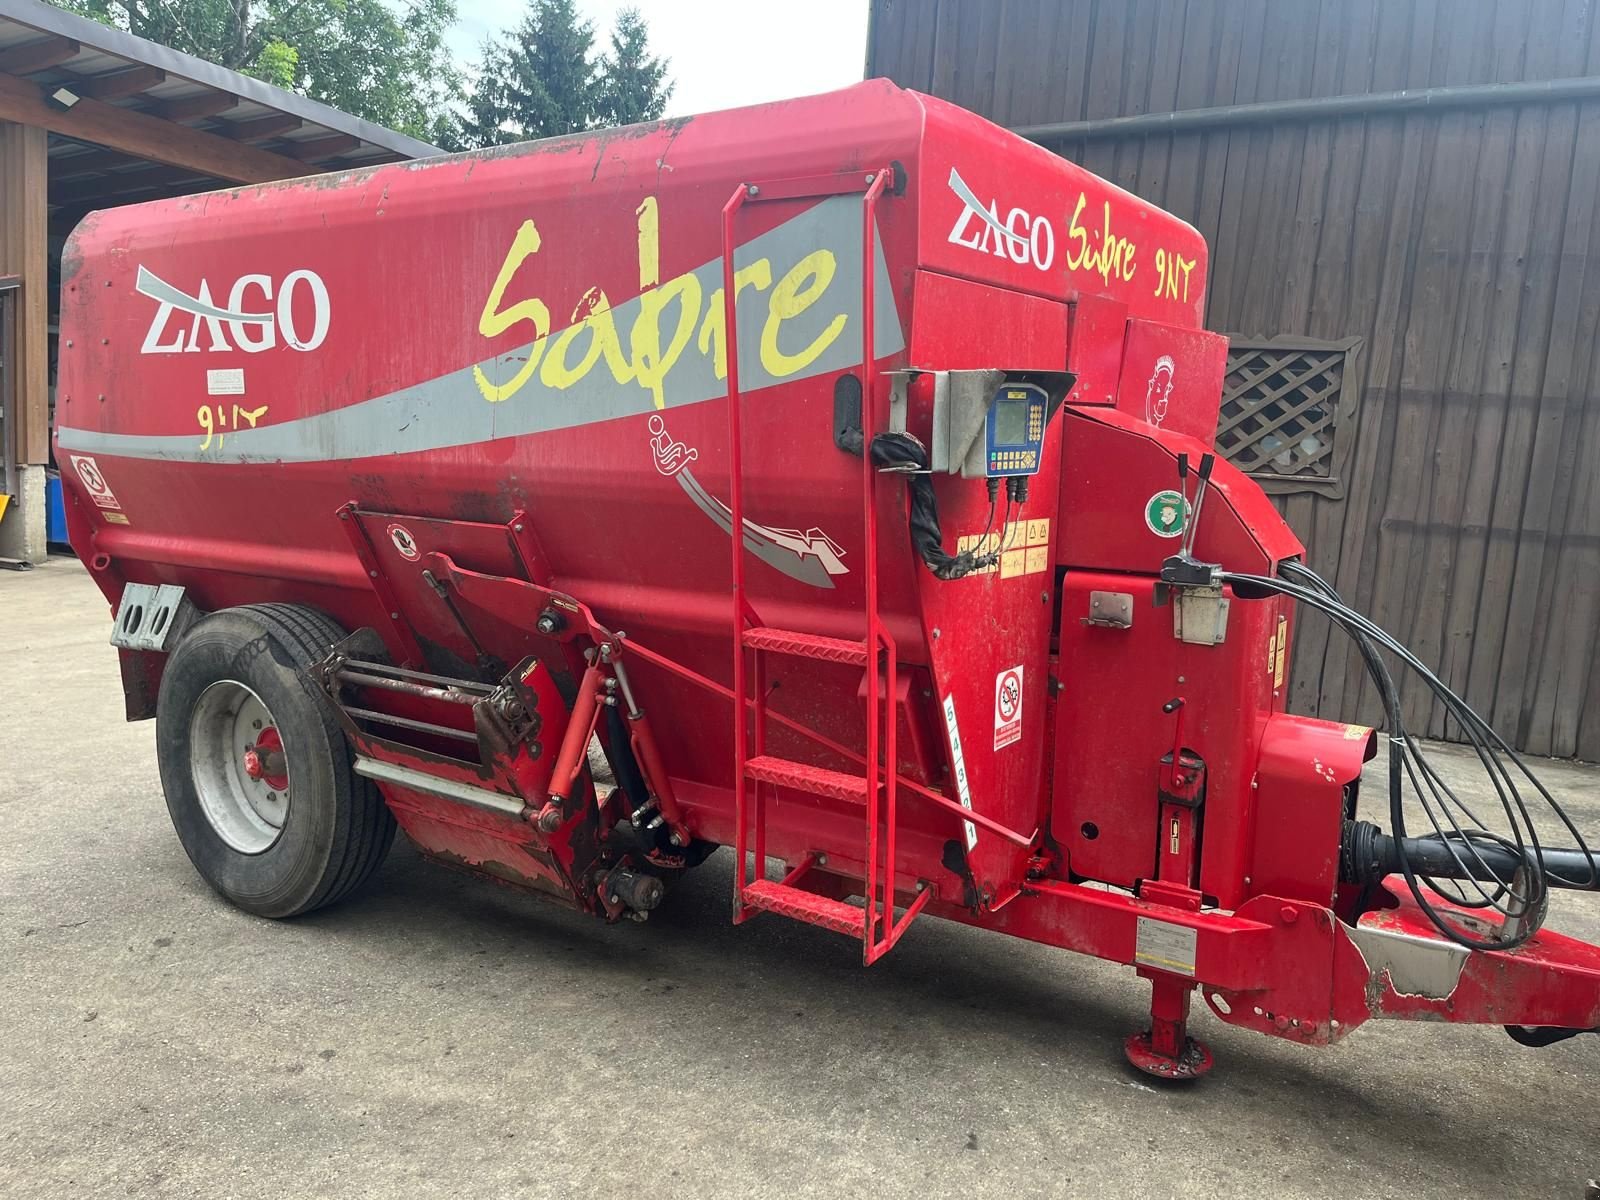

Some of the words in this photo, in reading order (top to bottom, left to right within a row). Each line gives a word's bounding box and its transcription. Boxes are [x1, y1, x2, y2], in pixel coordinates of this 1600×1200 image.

[948, 167, 1054, 271] ZAGO
[136, 264, 331, 353] ZAGO
[473, 195, 848, 410] Sabre
[947, 706, 954, 722] 5
[953, 737, 959, 752] 4
[958, 768, 965, 783] 3
[968, 826, 974, 838] 1
